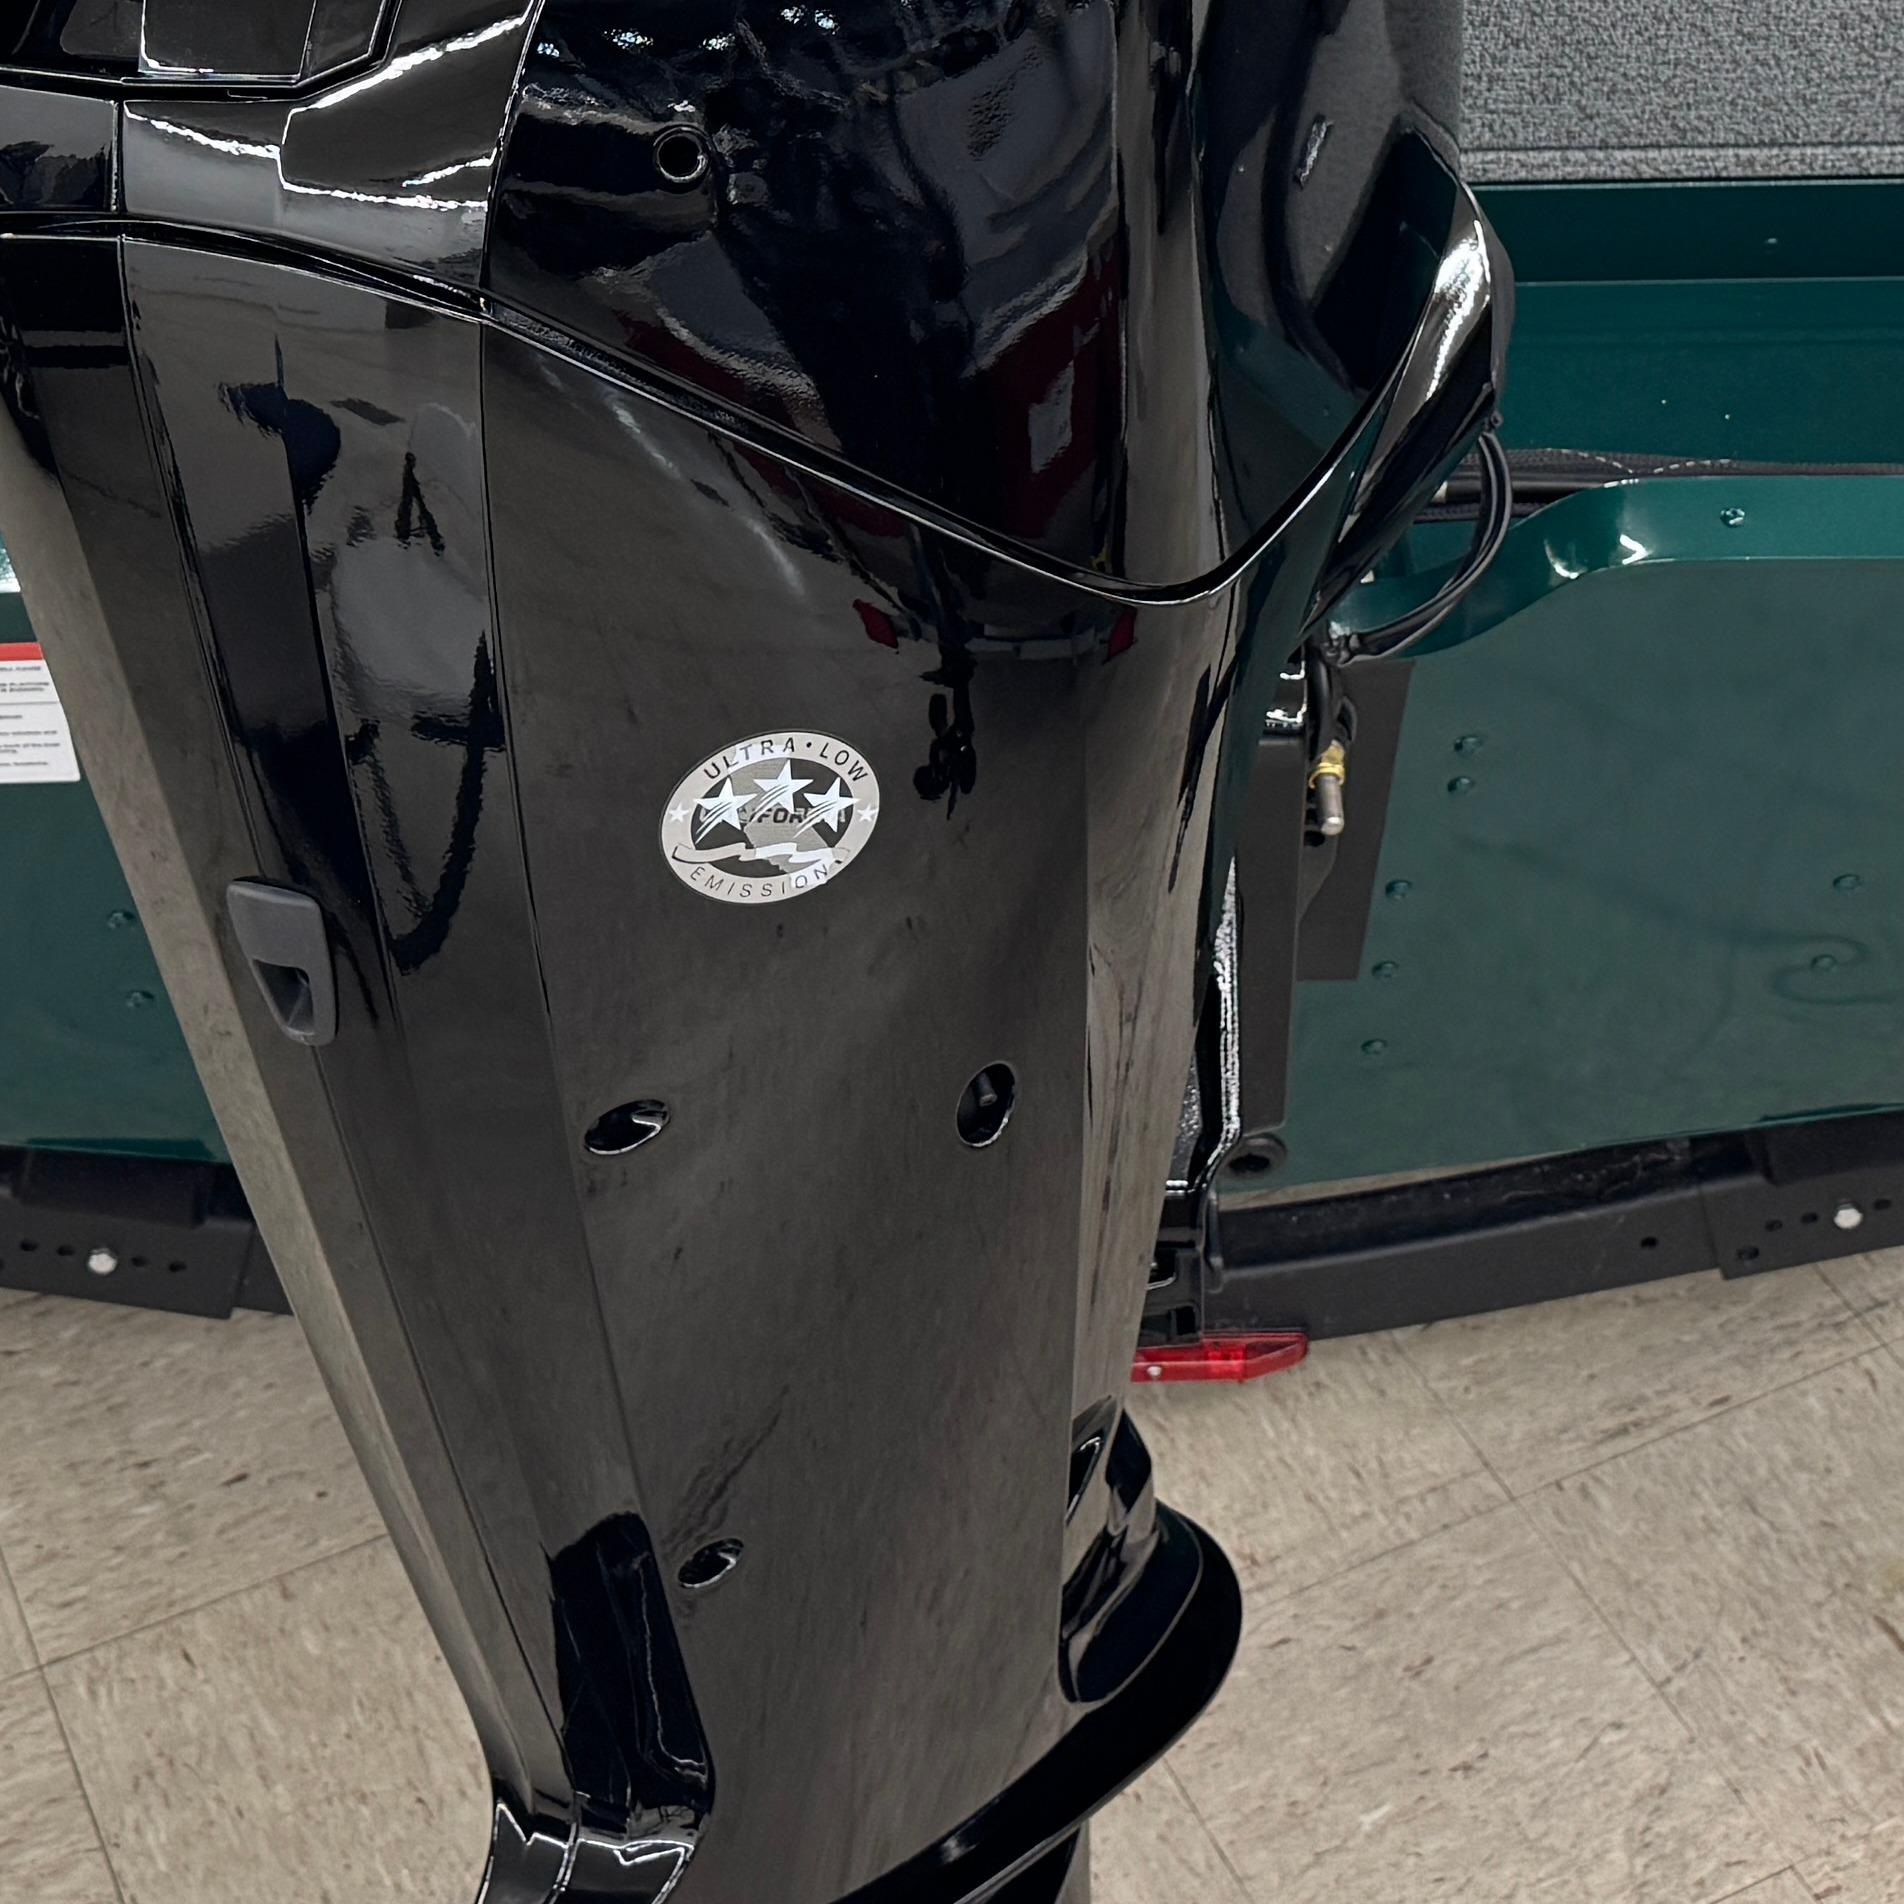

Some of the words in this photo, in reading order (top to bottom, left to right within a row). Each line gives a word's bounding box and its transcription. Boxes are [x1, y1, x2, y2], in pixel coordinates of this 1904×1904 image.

[703, 736, 797, 781] ULTRA
[819, 741, 869, 783] LOW
[689, 864, 829, 898] EMISSION
